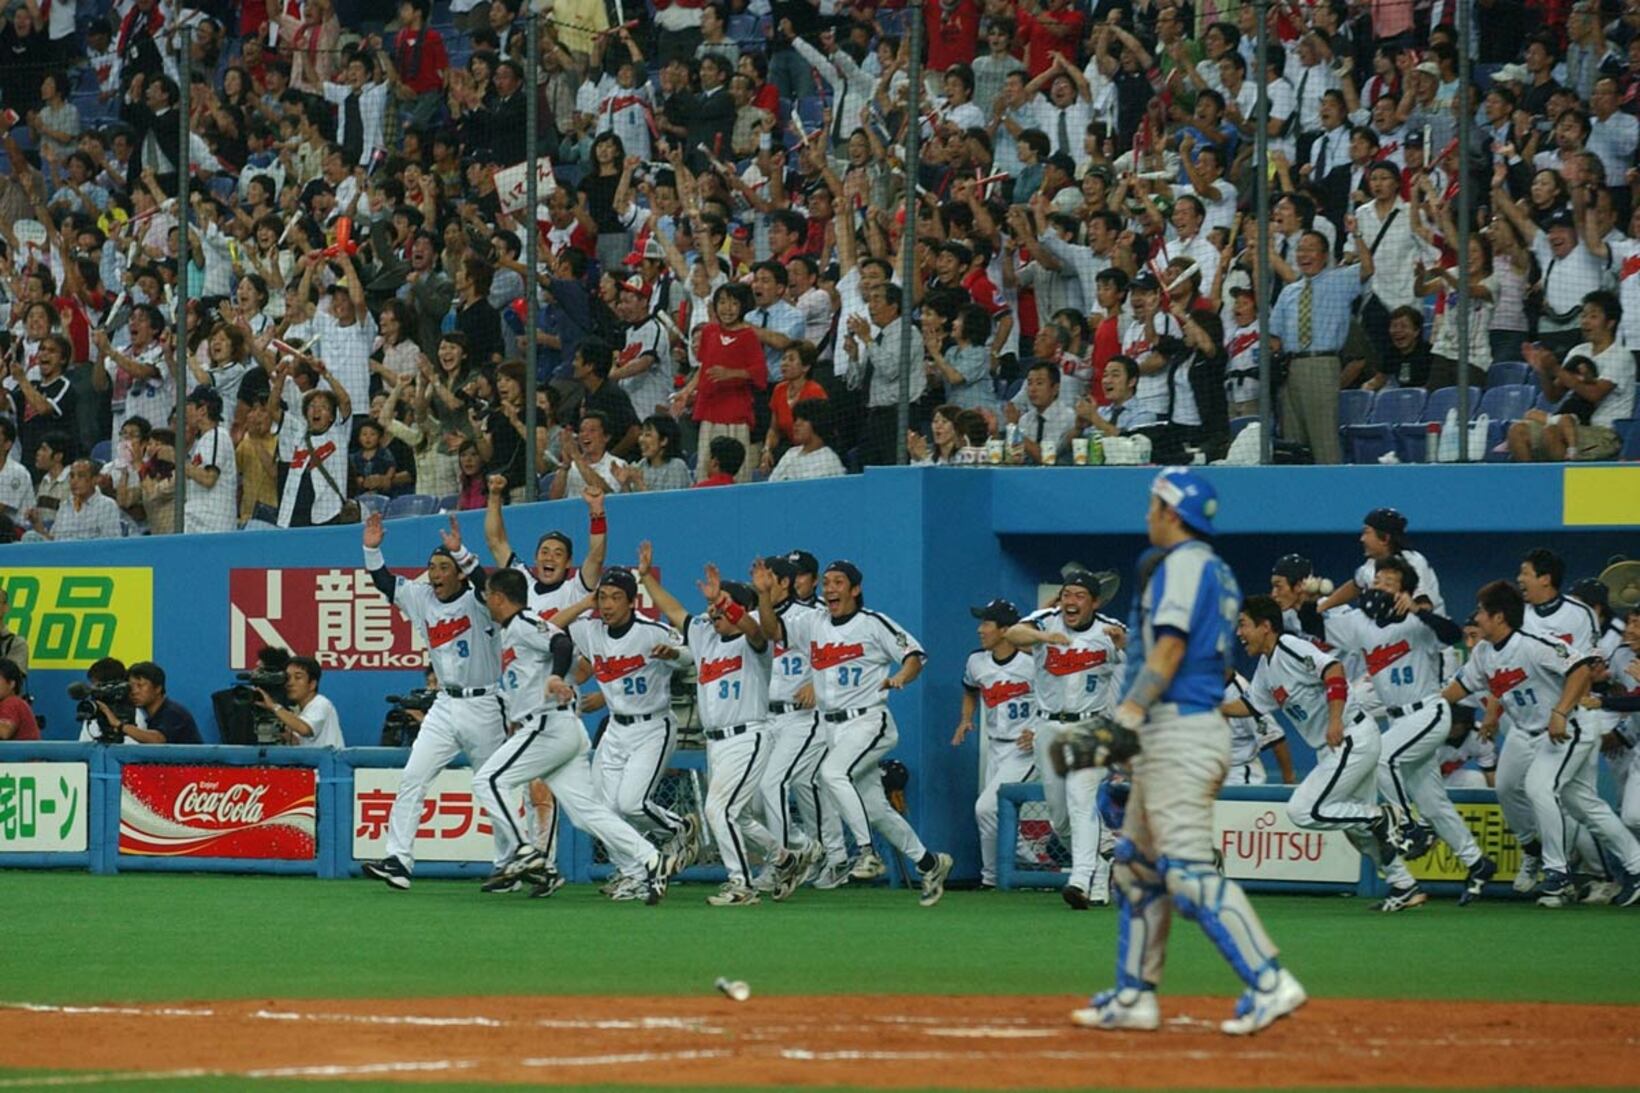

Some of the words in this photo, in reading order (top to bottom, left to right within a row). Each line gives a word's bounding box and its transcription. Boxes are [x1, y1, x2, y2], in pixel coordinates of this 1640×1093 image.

[781, 656, 803, 676] 12
[623, 676, 647, 695] 26
[838, 666, 863, 687] 37
[1086, 674, 1099, 692] 5
[719, 680, 741, 700] 31
[1008, 702, 1030, 720] 33
[174, 782, 270, 823] Coca-Cola
[1222, 830, 1324, 869] FUJITSU
